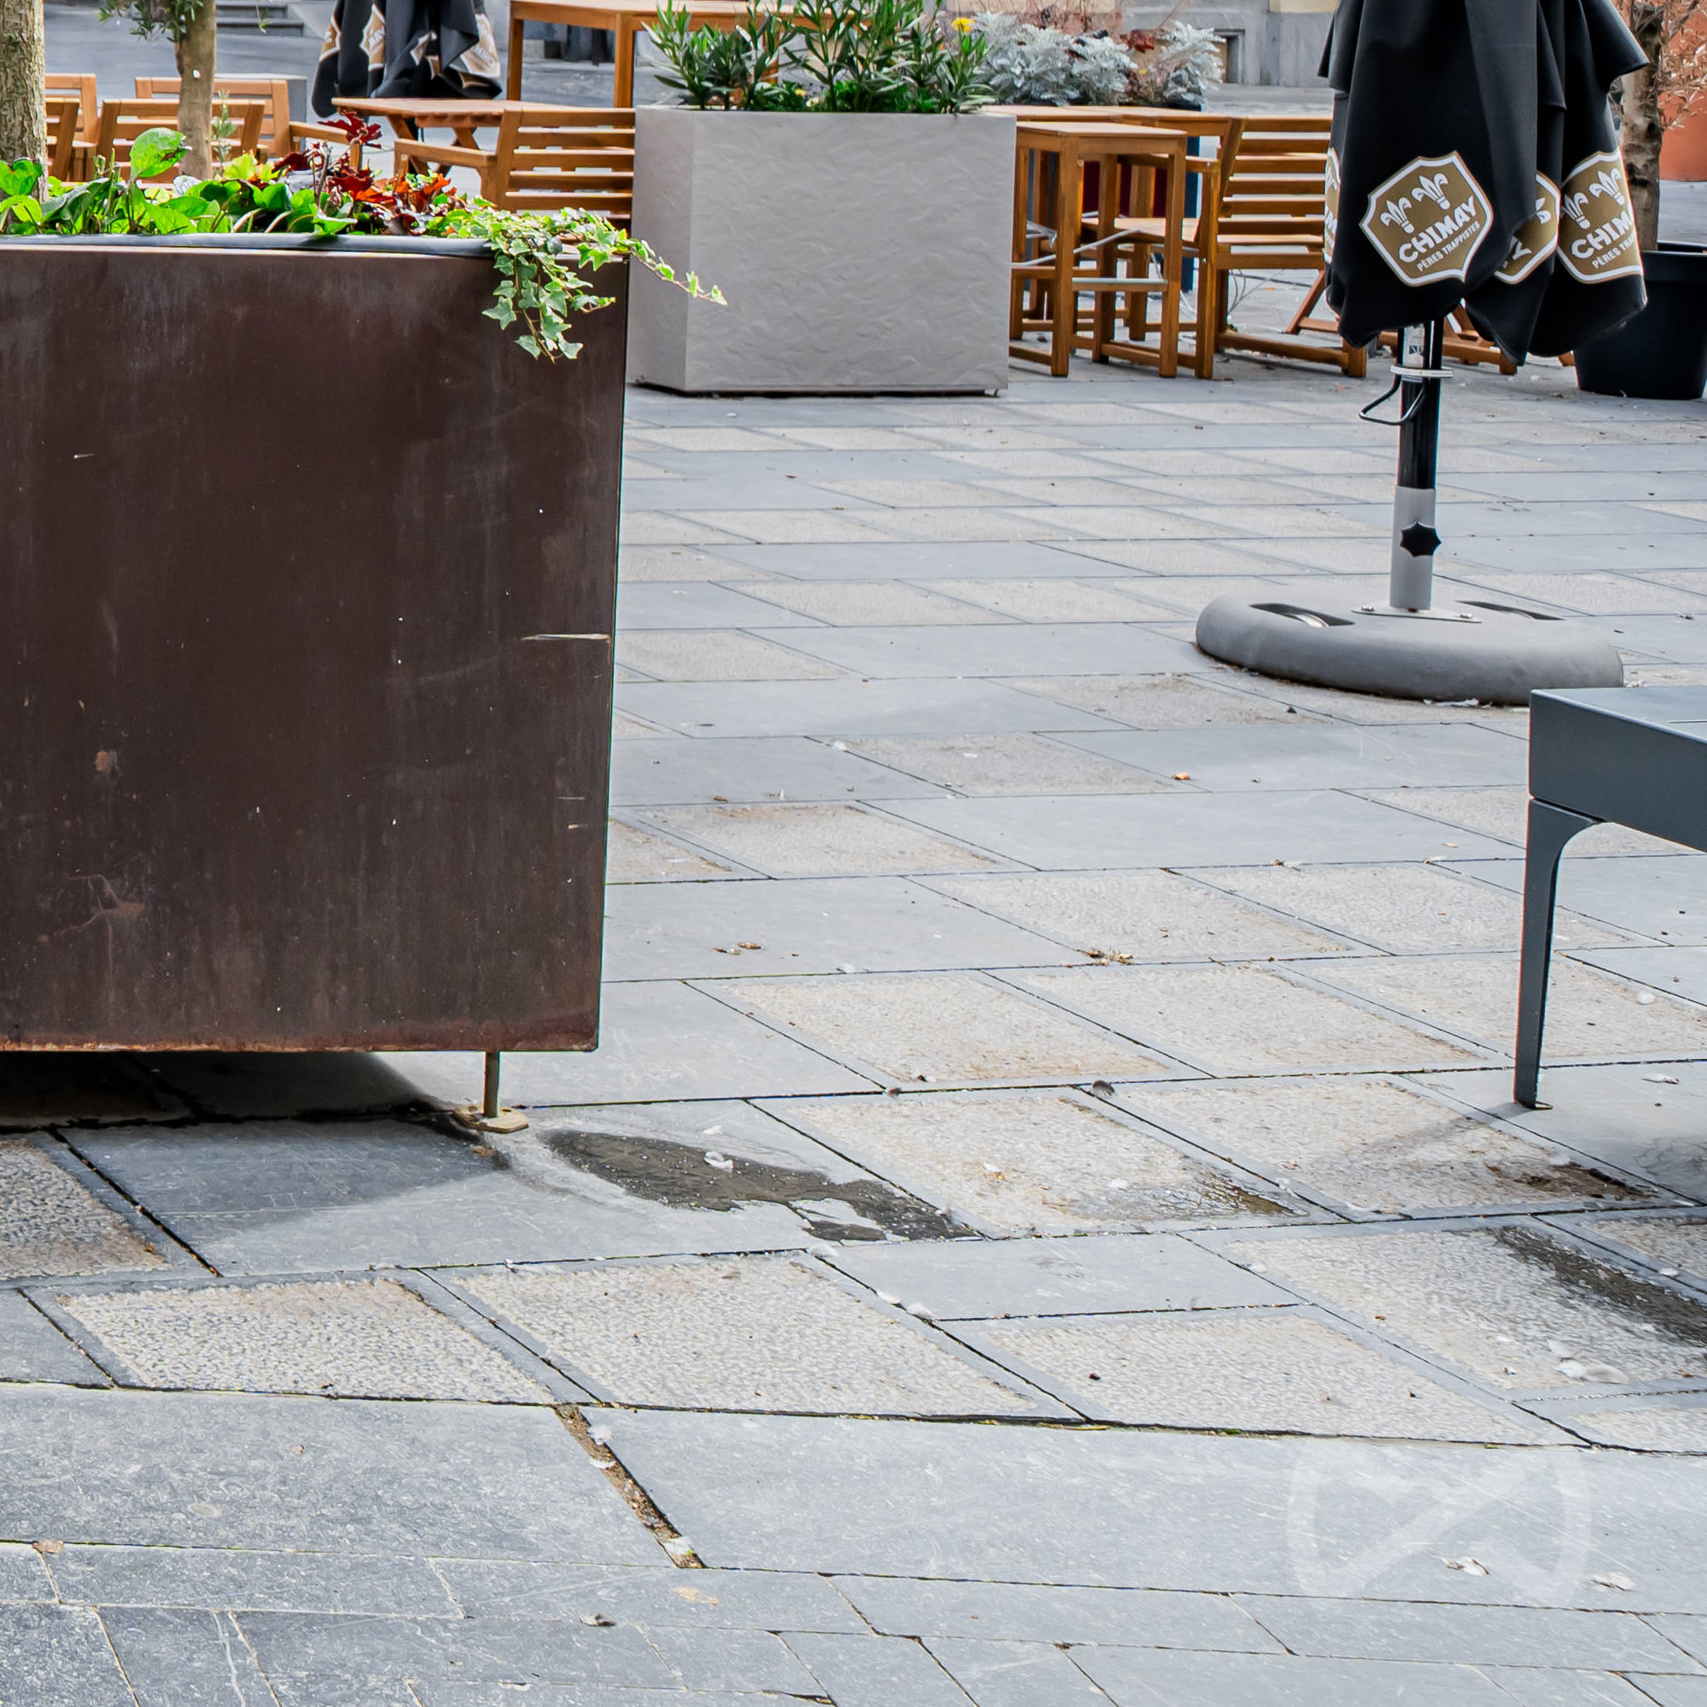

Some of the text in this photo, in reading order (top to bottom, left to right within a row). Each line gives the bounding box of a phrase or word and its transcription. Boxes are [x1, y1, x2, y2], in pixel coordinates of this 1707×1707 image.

[1398, 195, 1477, 263] CHIMAY
[1416, 250, 1444, 272] PÈRES
[1441, 220, 1481, 255] TRAPPISTES
[1571, 210, 1633, 259] CHIM
